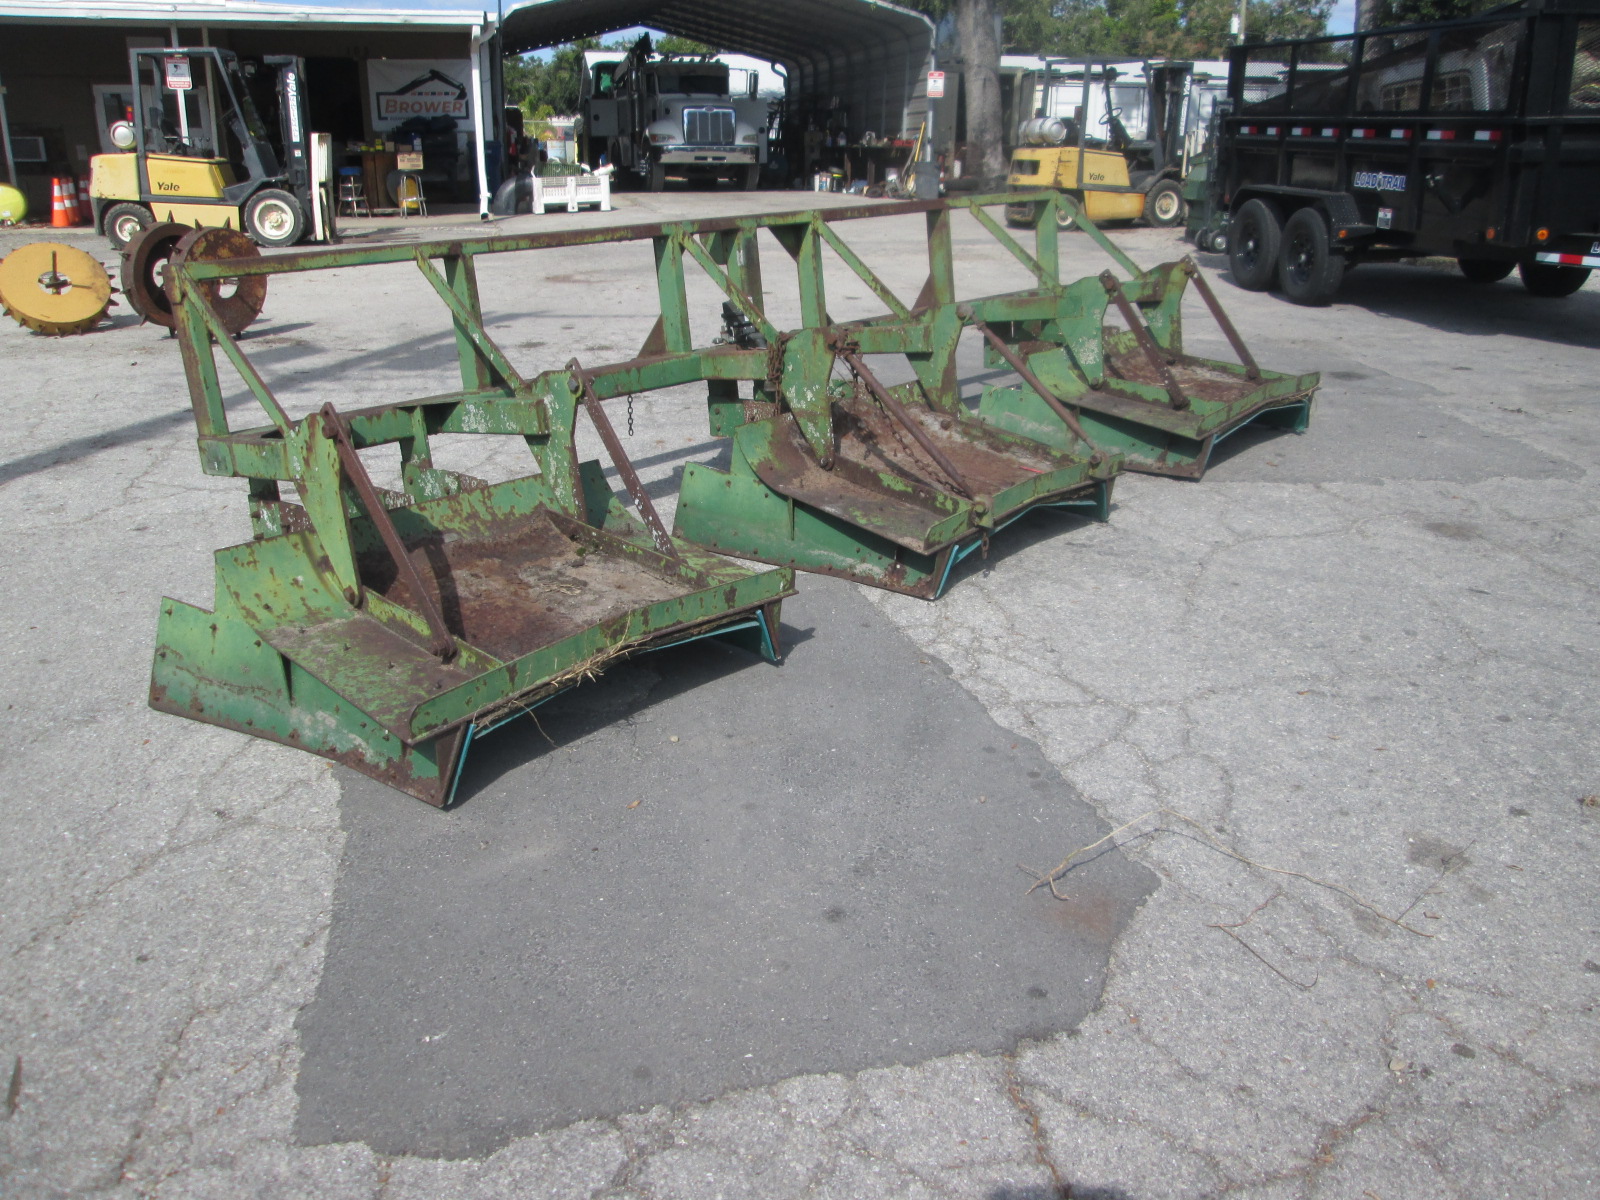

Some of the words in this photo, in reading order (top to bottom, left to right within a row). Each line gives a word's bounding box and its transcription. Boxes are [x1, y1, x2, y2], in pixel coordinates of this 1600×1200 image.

[287, 73, 297, 96] Yale
[1183, 75, 1192, 96] Yale
[385, 99, 464, 114] BROWER
[1089, 172, 1105, 181] Yale
[1354, 171, 1378, 188] LOAD
[1382, 174, 1406, 191] TRAIL
[157, 182, 180, 191] Yale
